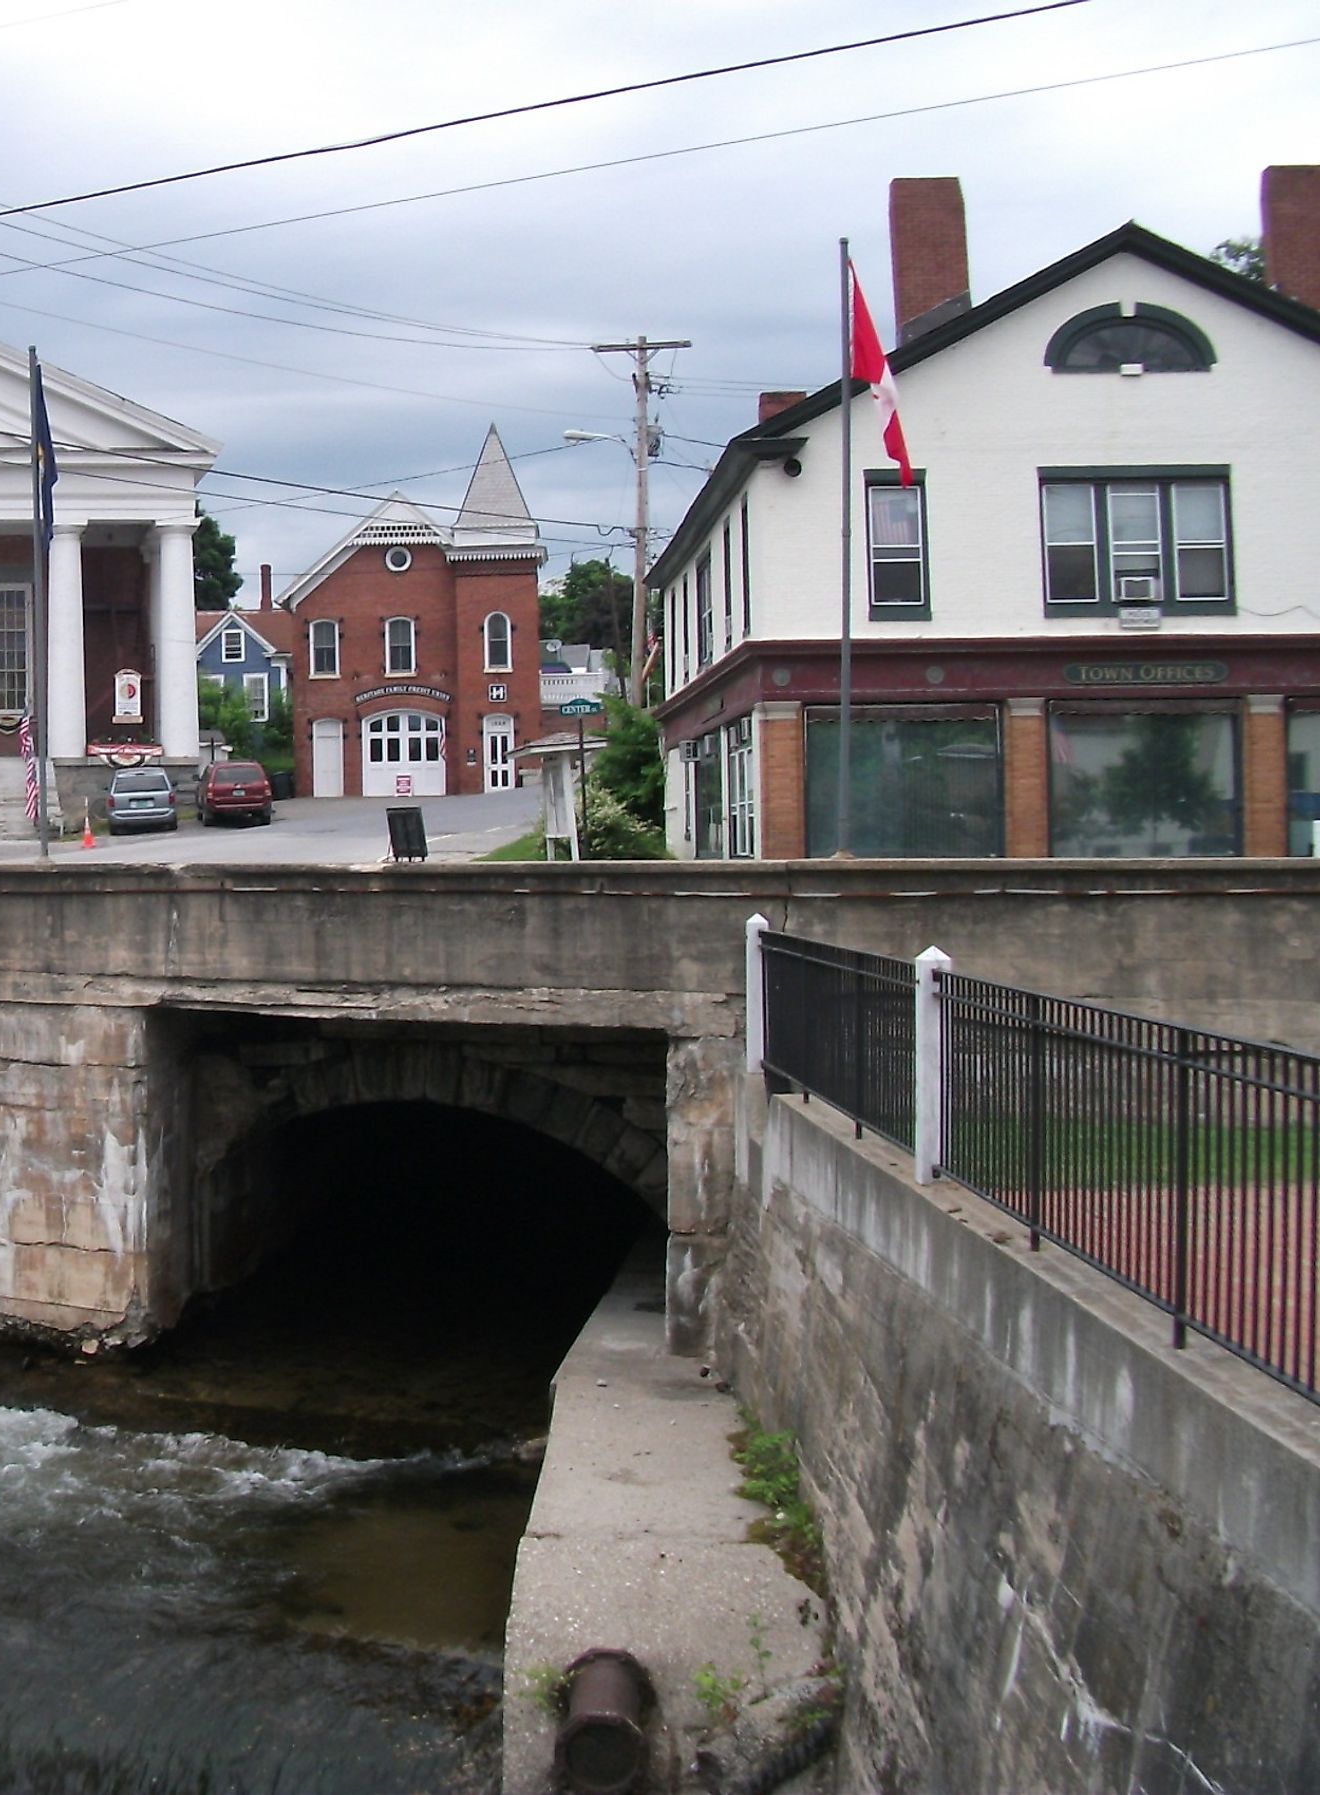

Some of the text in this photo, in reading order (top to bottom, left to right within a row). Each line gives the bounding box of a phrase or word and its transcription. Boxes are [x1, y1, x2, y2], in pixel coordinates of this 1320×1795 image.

[1079, 663, 1215, 681] TOWN OFFICES
[561, 704, 591, 715] CENTER
